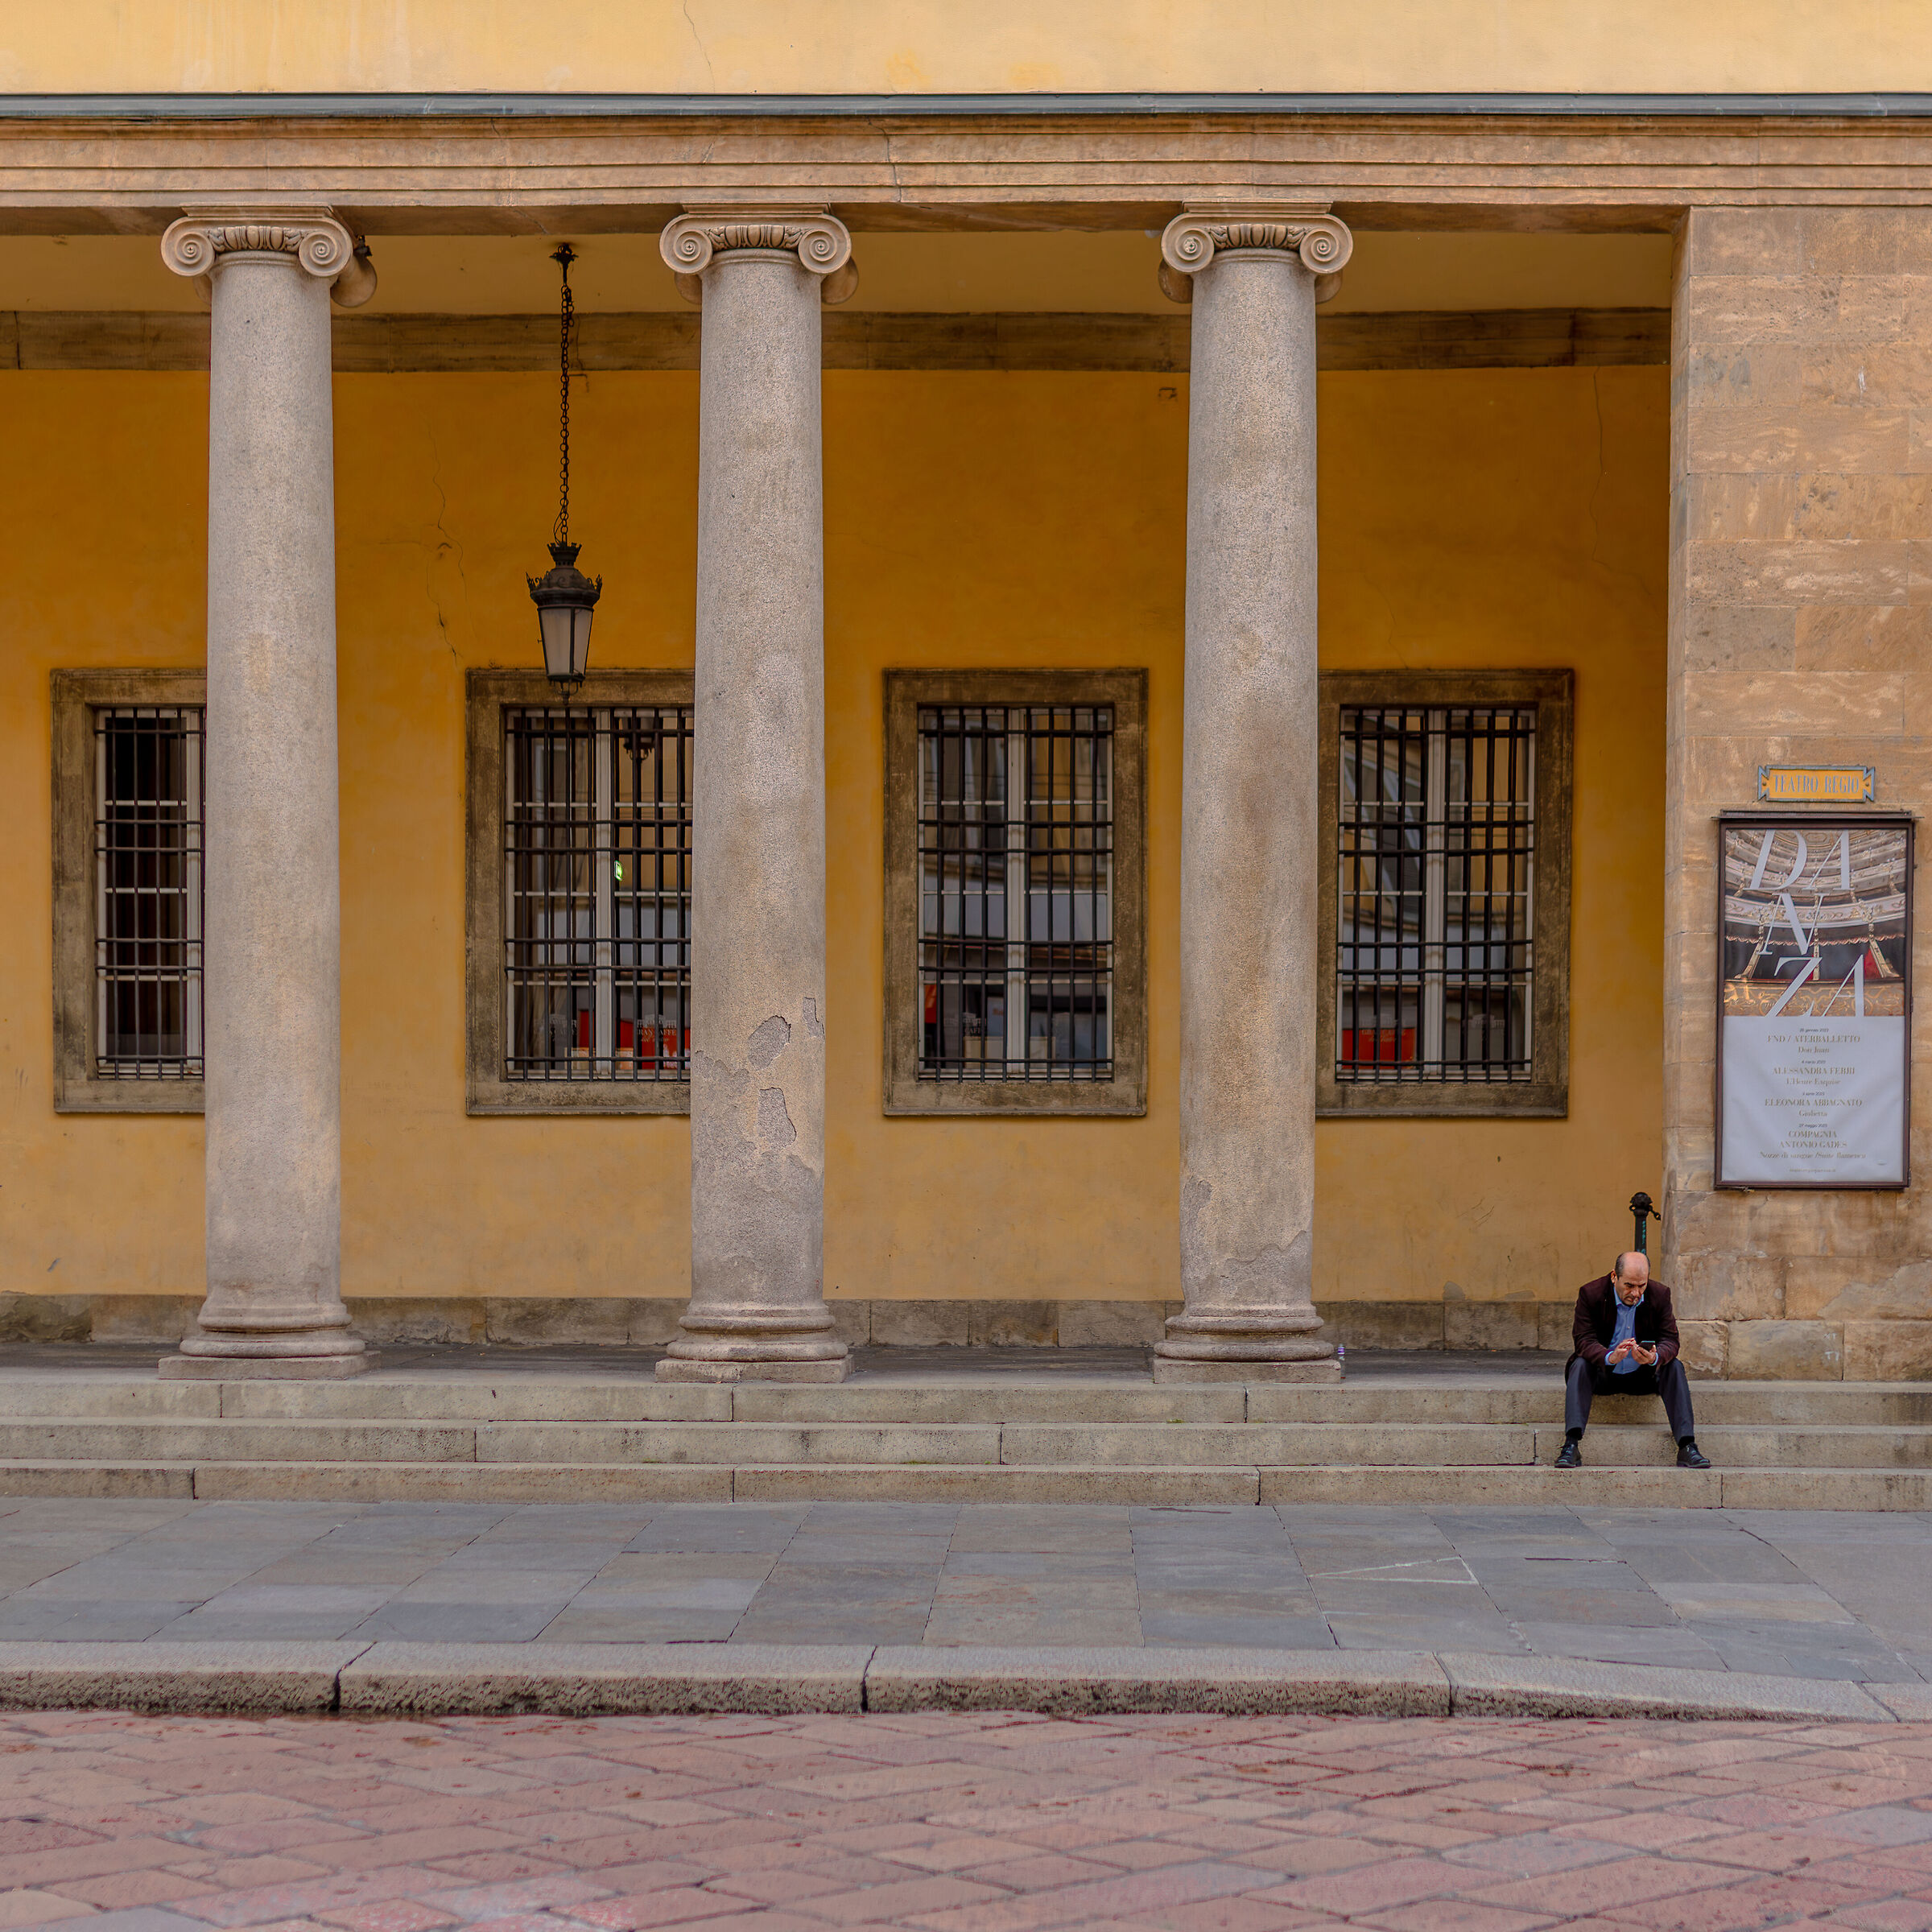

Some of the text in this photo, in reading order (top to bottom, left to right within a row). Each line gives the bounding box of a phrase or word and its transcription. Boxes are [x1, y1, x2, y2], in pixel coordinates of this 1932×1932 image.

[1773, 774, 1860, 795] TEATRO REGIO
[1764, 1098, 1810, 1107] ELEONORA
[1788, 1130, 1837, 1138] COMPAGNIA
[1778, 1140, 1818, 1148] ANTONIO
